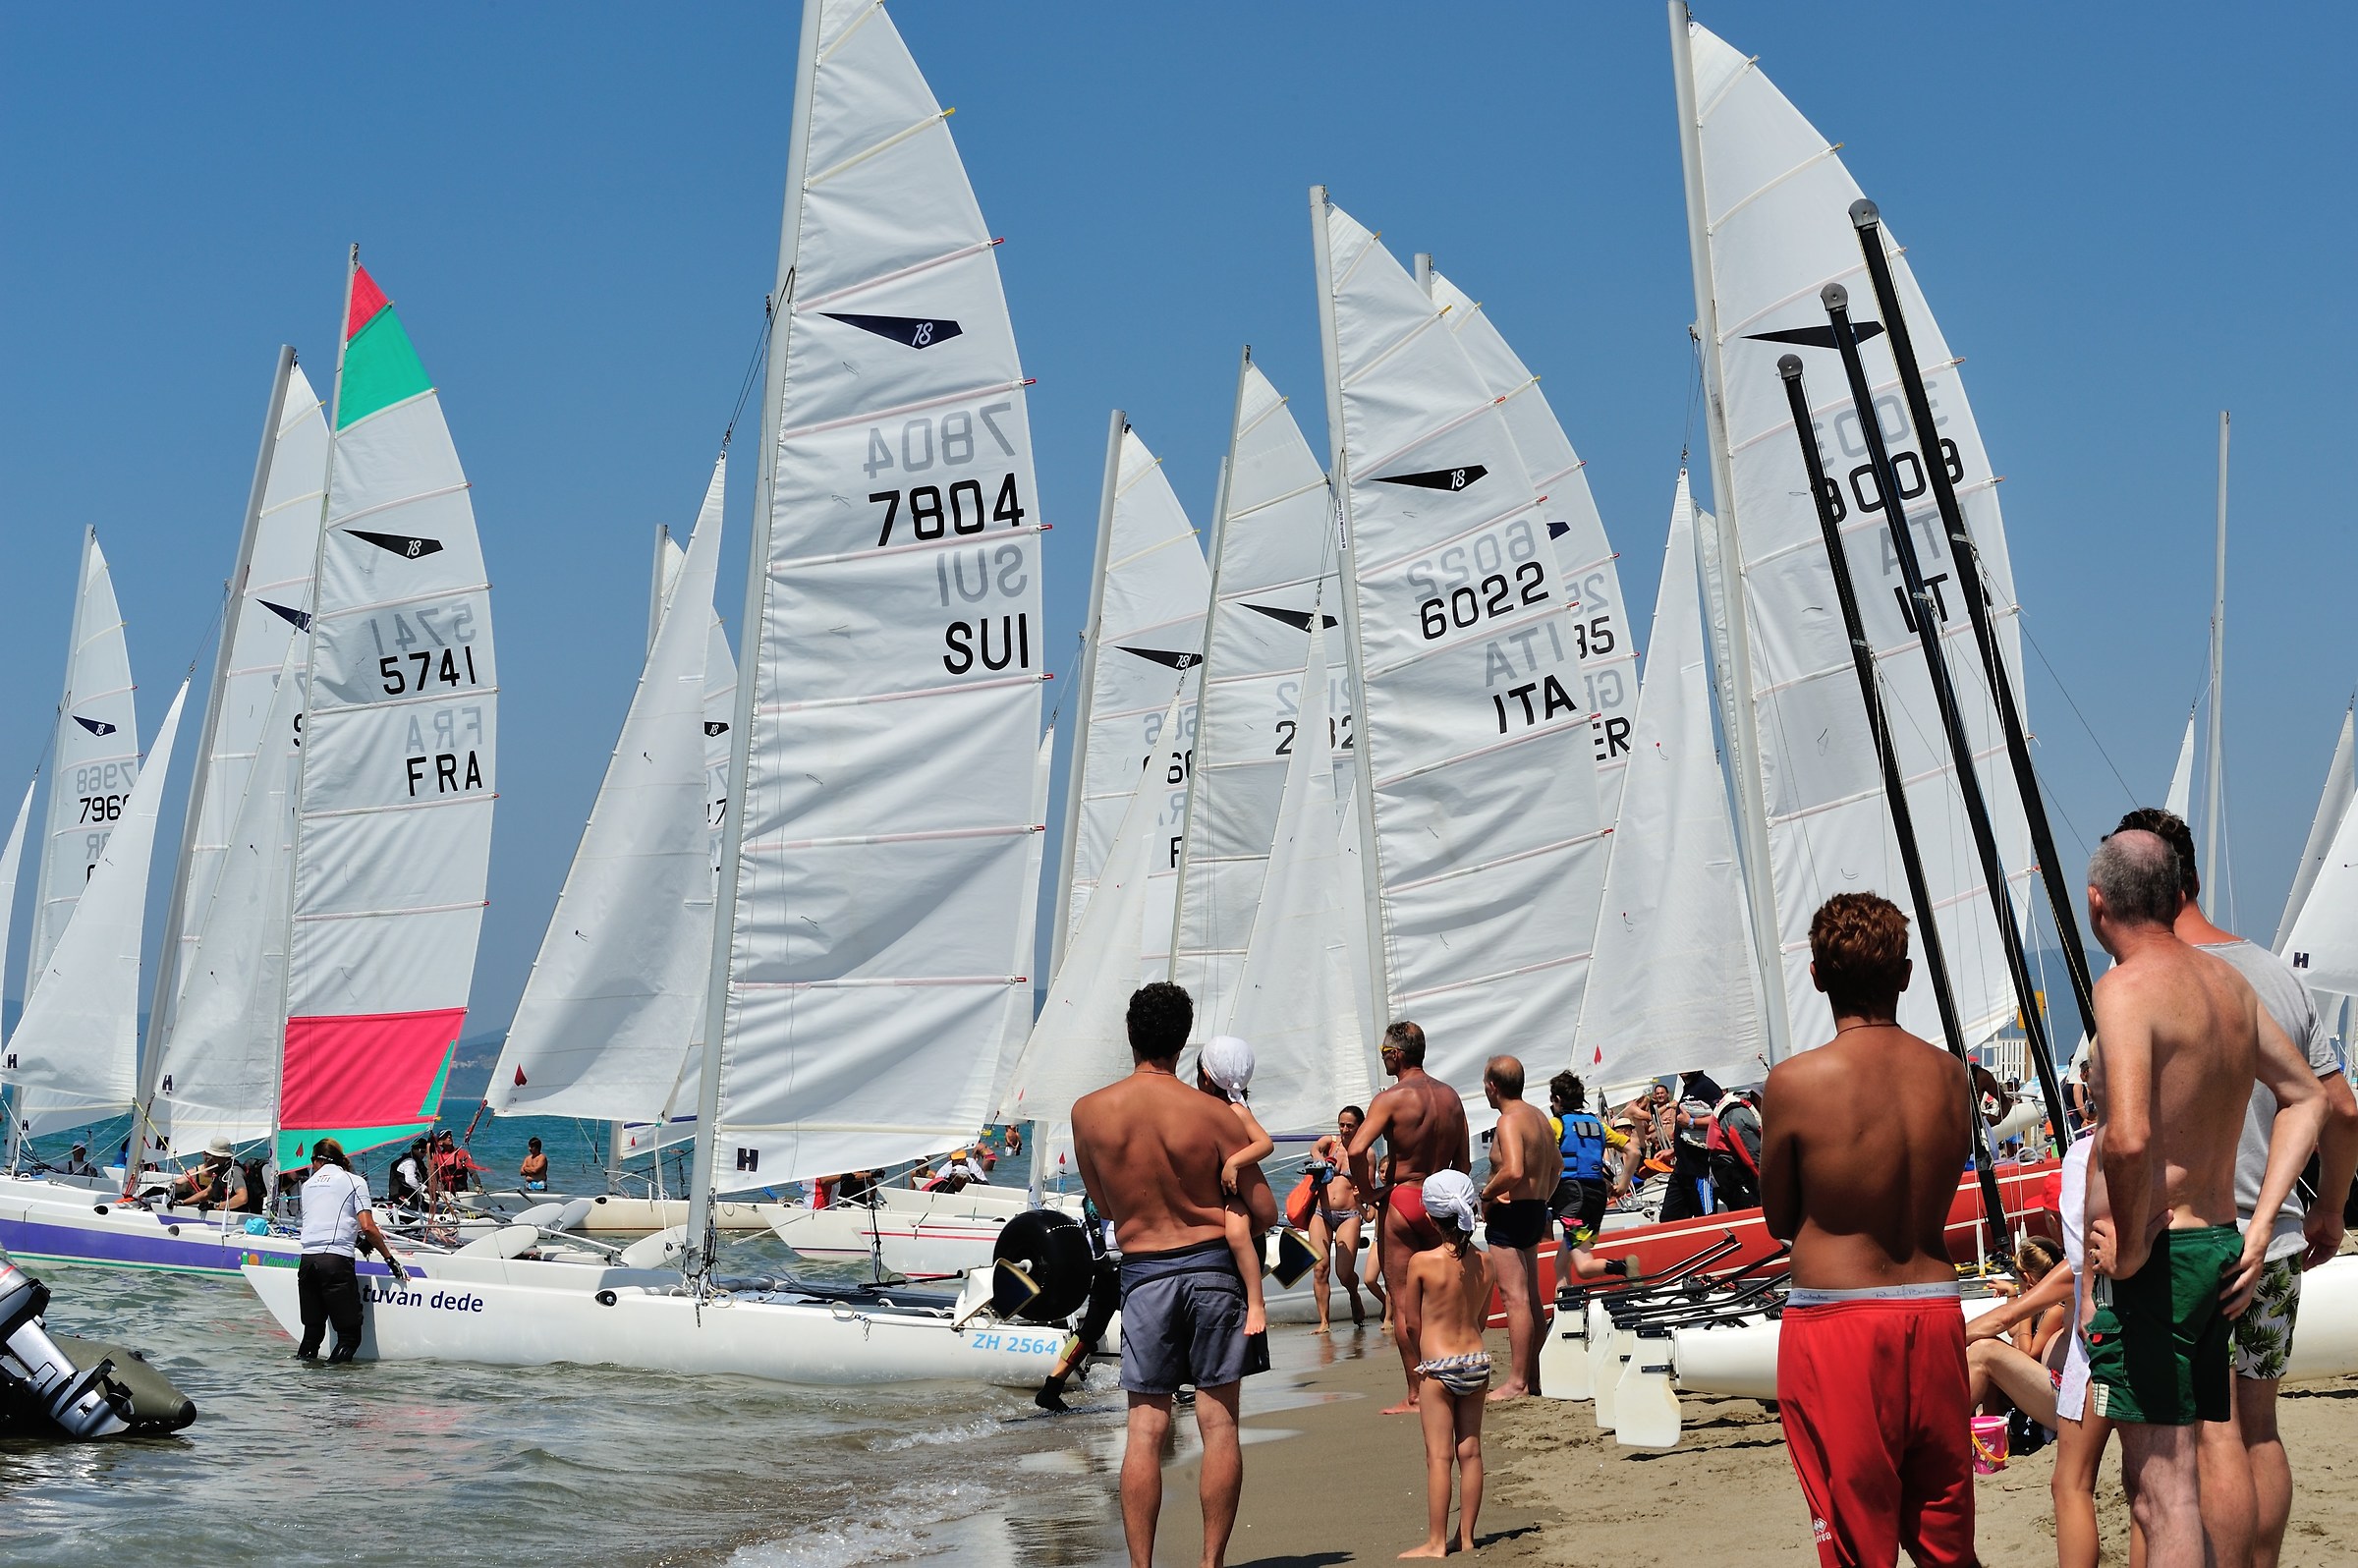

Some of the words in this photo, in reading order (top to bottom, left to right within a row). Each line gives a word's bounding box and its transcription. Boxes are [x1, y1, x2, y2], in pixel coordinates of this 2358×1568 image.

[912, 321, 934, 347] 18
[1450, 469, 1466, 489] 18
[869, 473, 1025, 547] 7804
[406, 539, 422, 557] 18
[1420, 561, 1549, 641] 6022
[942, 612, 1029, 675] SUI
[379, 645, 477, 696] 5741
[1492, 674, 1578, 735] ITA
[406, 751, 483, 797] FRA
[363, 1284, 422, 1307] tuvan
[430, 1290, 483, 1313] dede
[972, 1333, 1001, 1351] ZH
[1006, 1336, 1057, 1355] 2564
